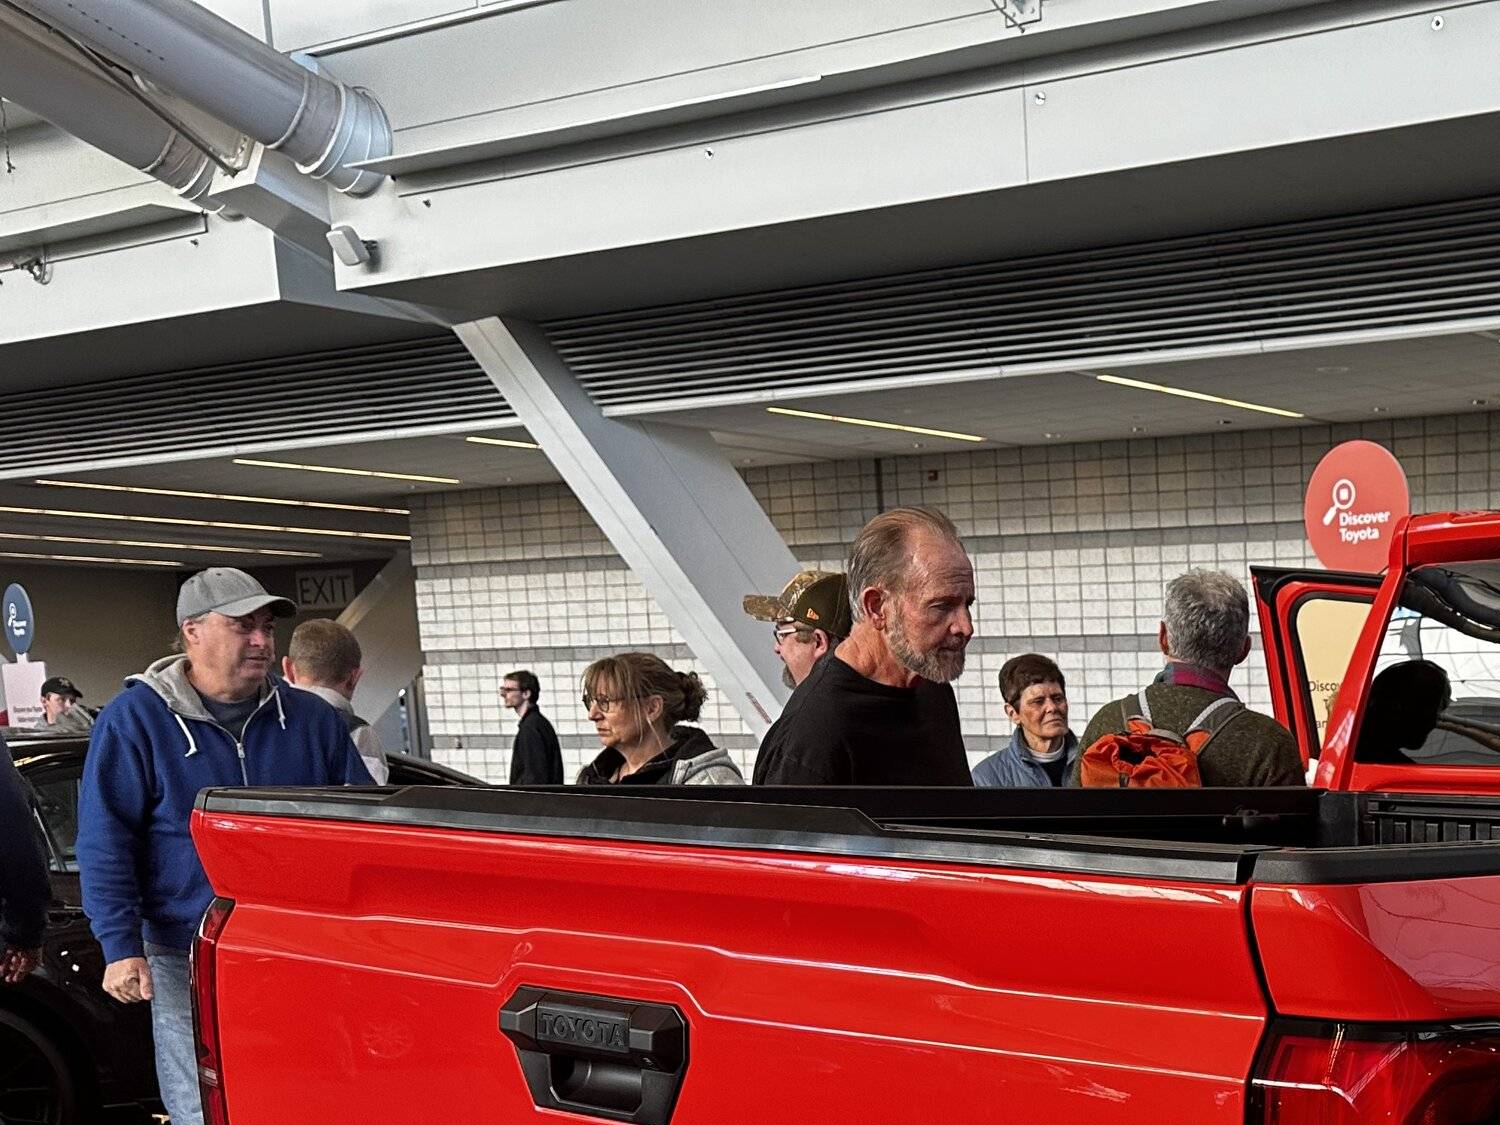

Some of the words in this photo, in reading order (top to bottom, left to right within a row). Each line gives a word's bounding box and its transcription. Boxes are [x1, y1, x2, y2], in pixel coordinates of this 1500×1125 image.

[1339, 511, 1391, 527] Discover
[1339, 527, 1380, 544] Toyota
[300, 575, 351, 605] EXIT
[1309, 680, 1340, 692] Disco
[539, 1012, 626, 1048] TOYOTA
